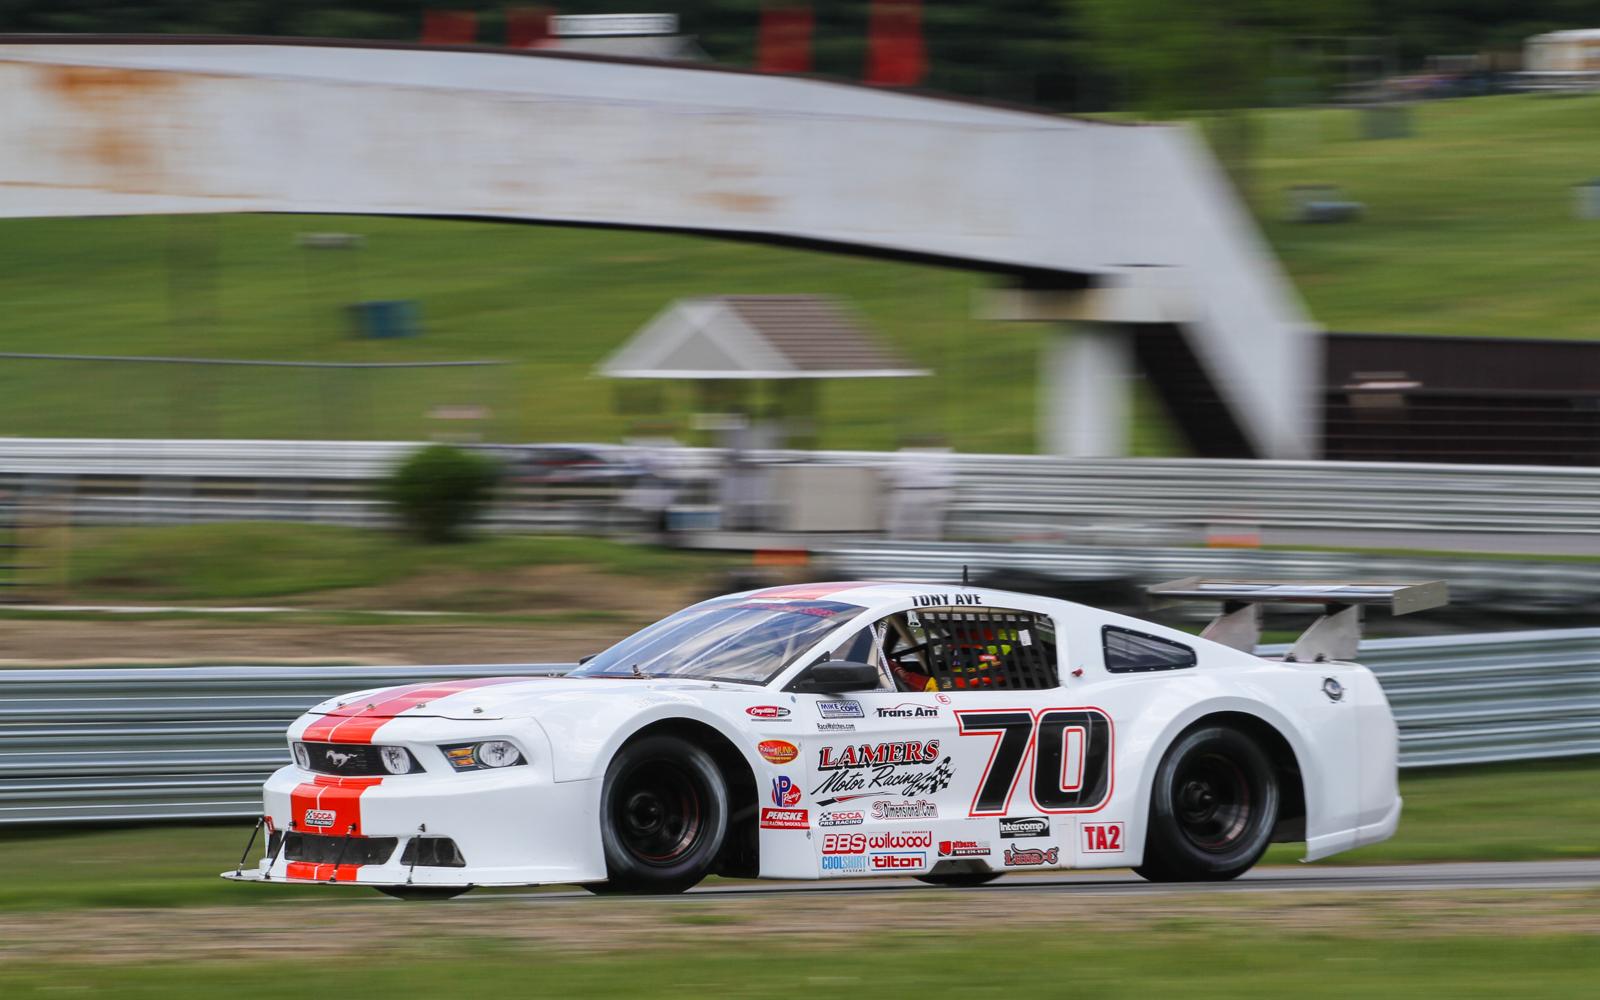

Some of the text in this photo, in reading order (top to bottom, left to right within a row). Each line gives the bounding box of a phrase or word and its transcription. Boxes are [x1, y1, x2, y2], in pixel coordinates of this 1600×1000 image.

[911, 594, 982, 607] TONY AVE
[820, 703, 860, 712] MIKE COPE
[876, 707, 938, 718] Trans Am
[818, 740, 939, 771] LAMERS
[953, 706, 1115, 817] 70
[810, 765, 928, 796] Motor Racing
[772, 775, 791, 807] VP
[766, 811, 804, 821] PENSKE
[832, 812, 862, 820] SCCA
[1000, 822, 1044, 832] Intercomp
[822, 834, 867, 854] BBS
[869, 831, 932, 848] wilwood
[1084, 825, 1120, 850] TA2
[822, 855, 867, 869] COOLSHIRT
[872, 855, 922, 868] tilton
